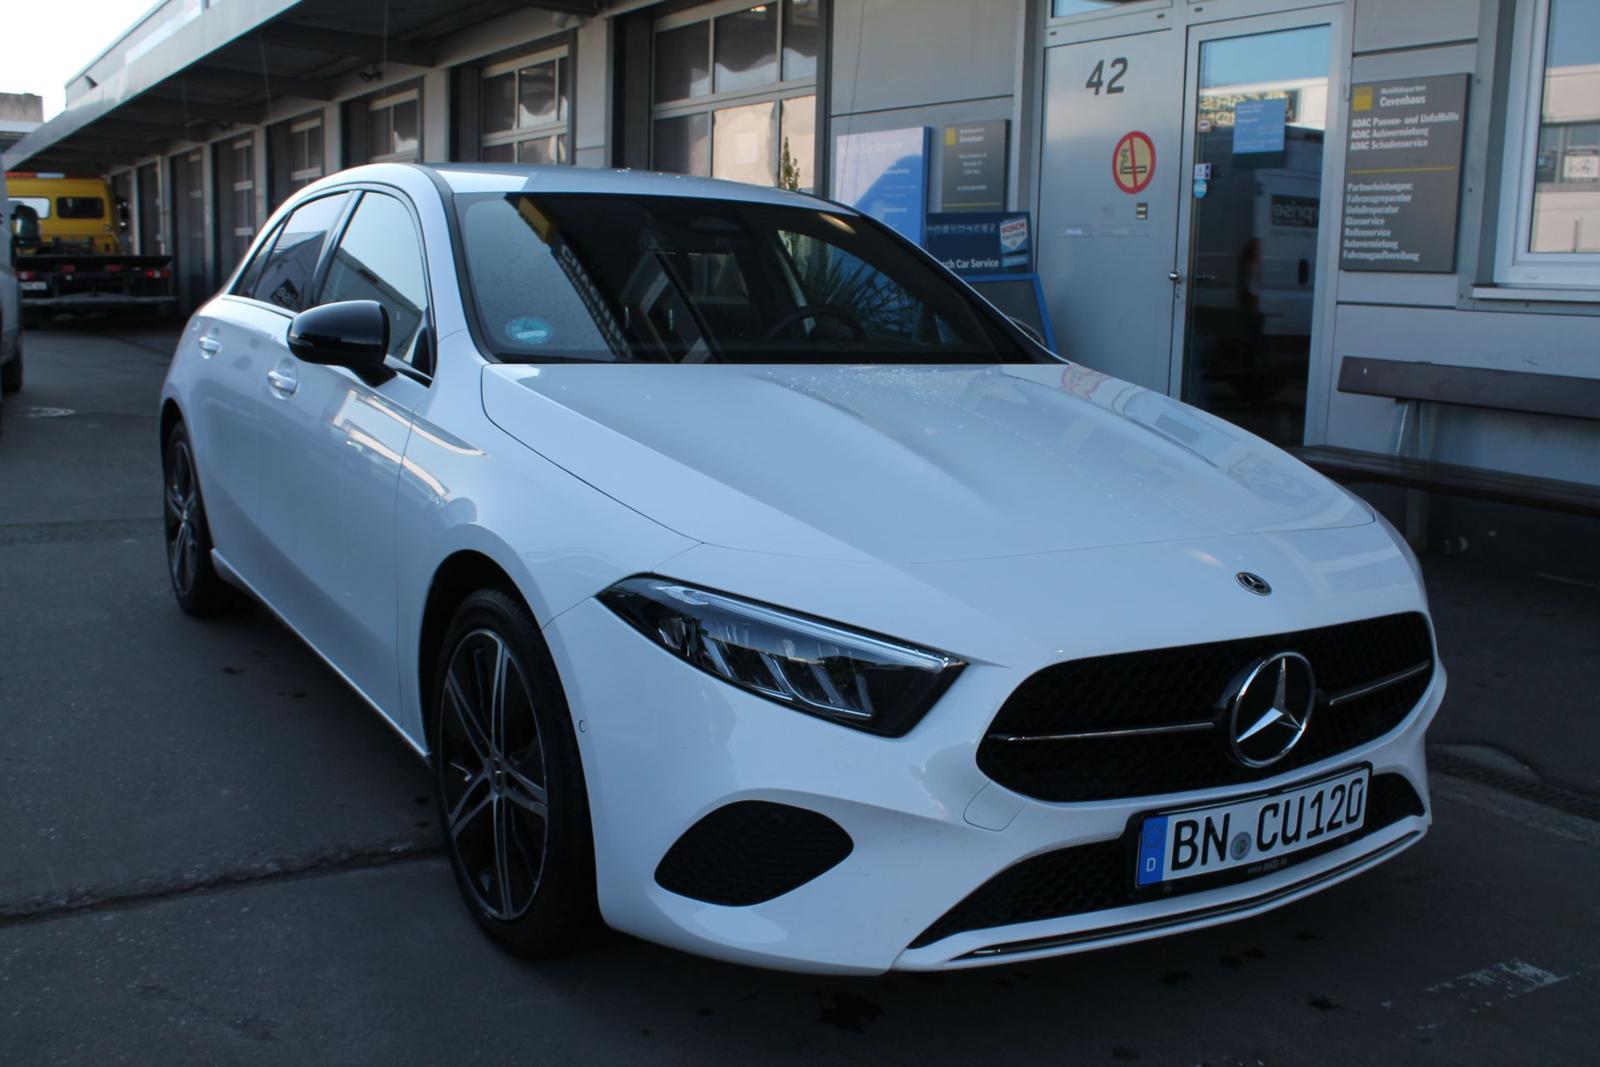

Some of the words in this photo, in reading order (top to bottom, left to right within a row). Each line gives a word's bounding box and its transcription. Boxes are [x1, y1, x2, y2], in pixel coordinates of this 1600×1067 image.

[1085, 57, 1129, 96] 42
[1351, 118, 1371, 128] ADAC
[1404, 115, 1419, 125] und
[1350, 129, 1371, 139] ADAC
[1371, 127, 1431, 138] Autovermietung
[1349, 141, 1370, 150] ADAC
[1001, 222, 1025, 234] BOSCH
[956, 259, 969, 269] Car
[970, 257, 1000, 269] Service
[1145, 857, 1157, 872] D
[1170, 812, 1231, 872] BN
